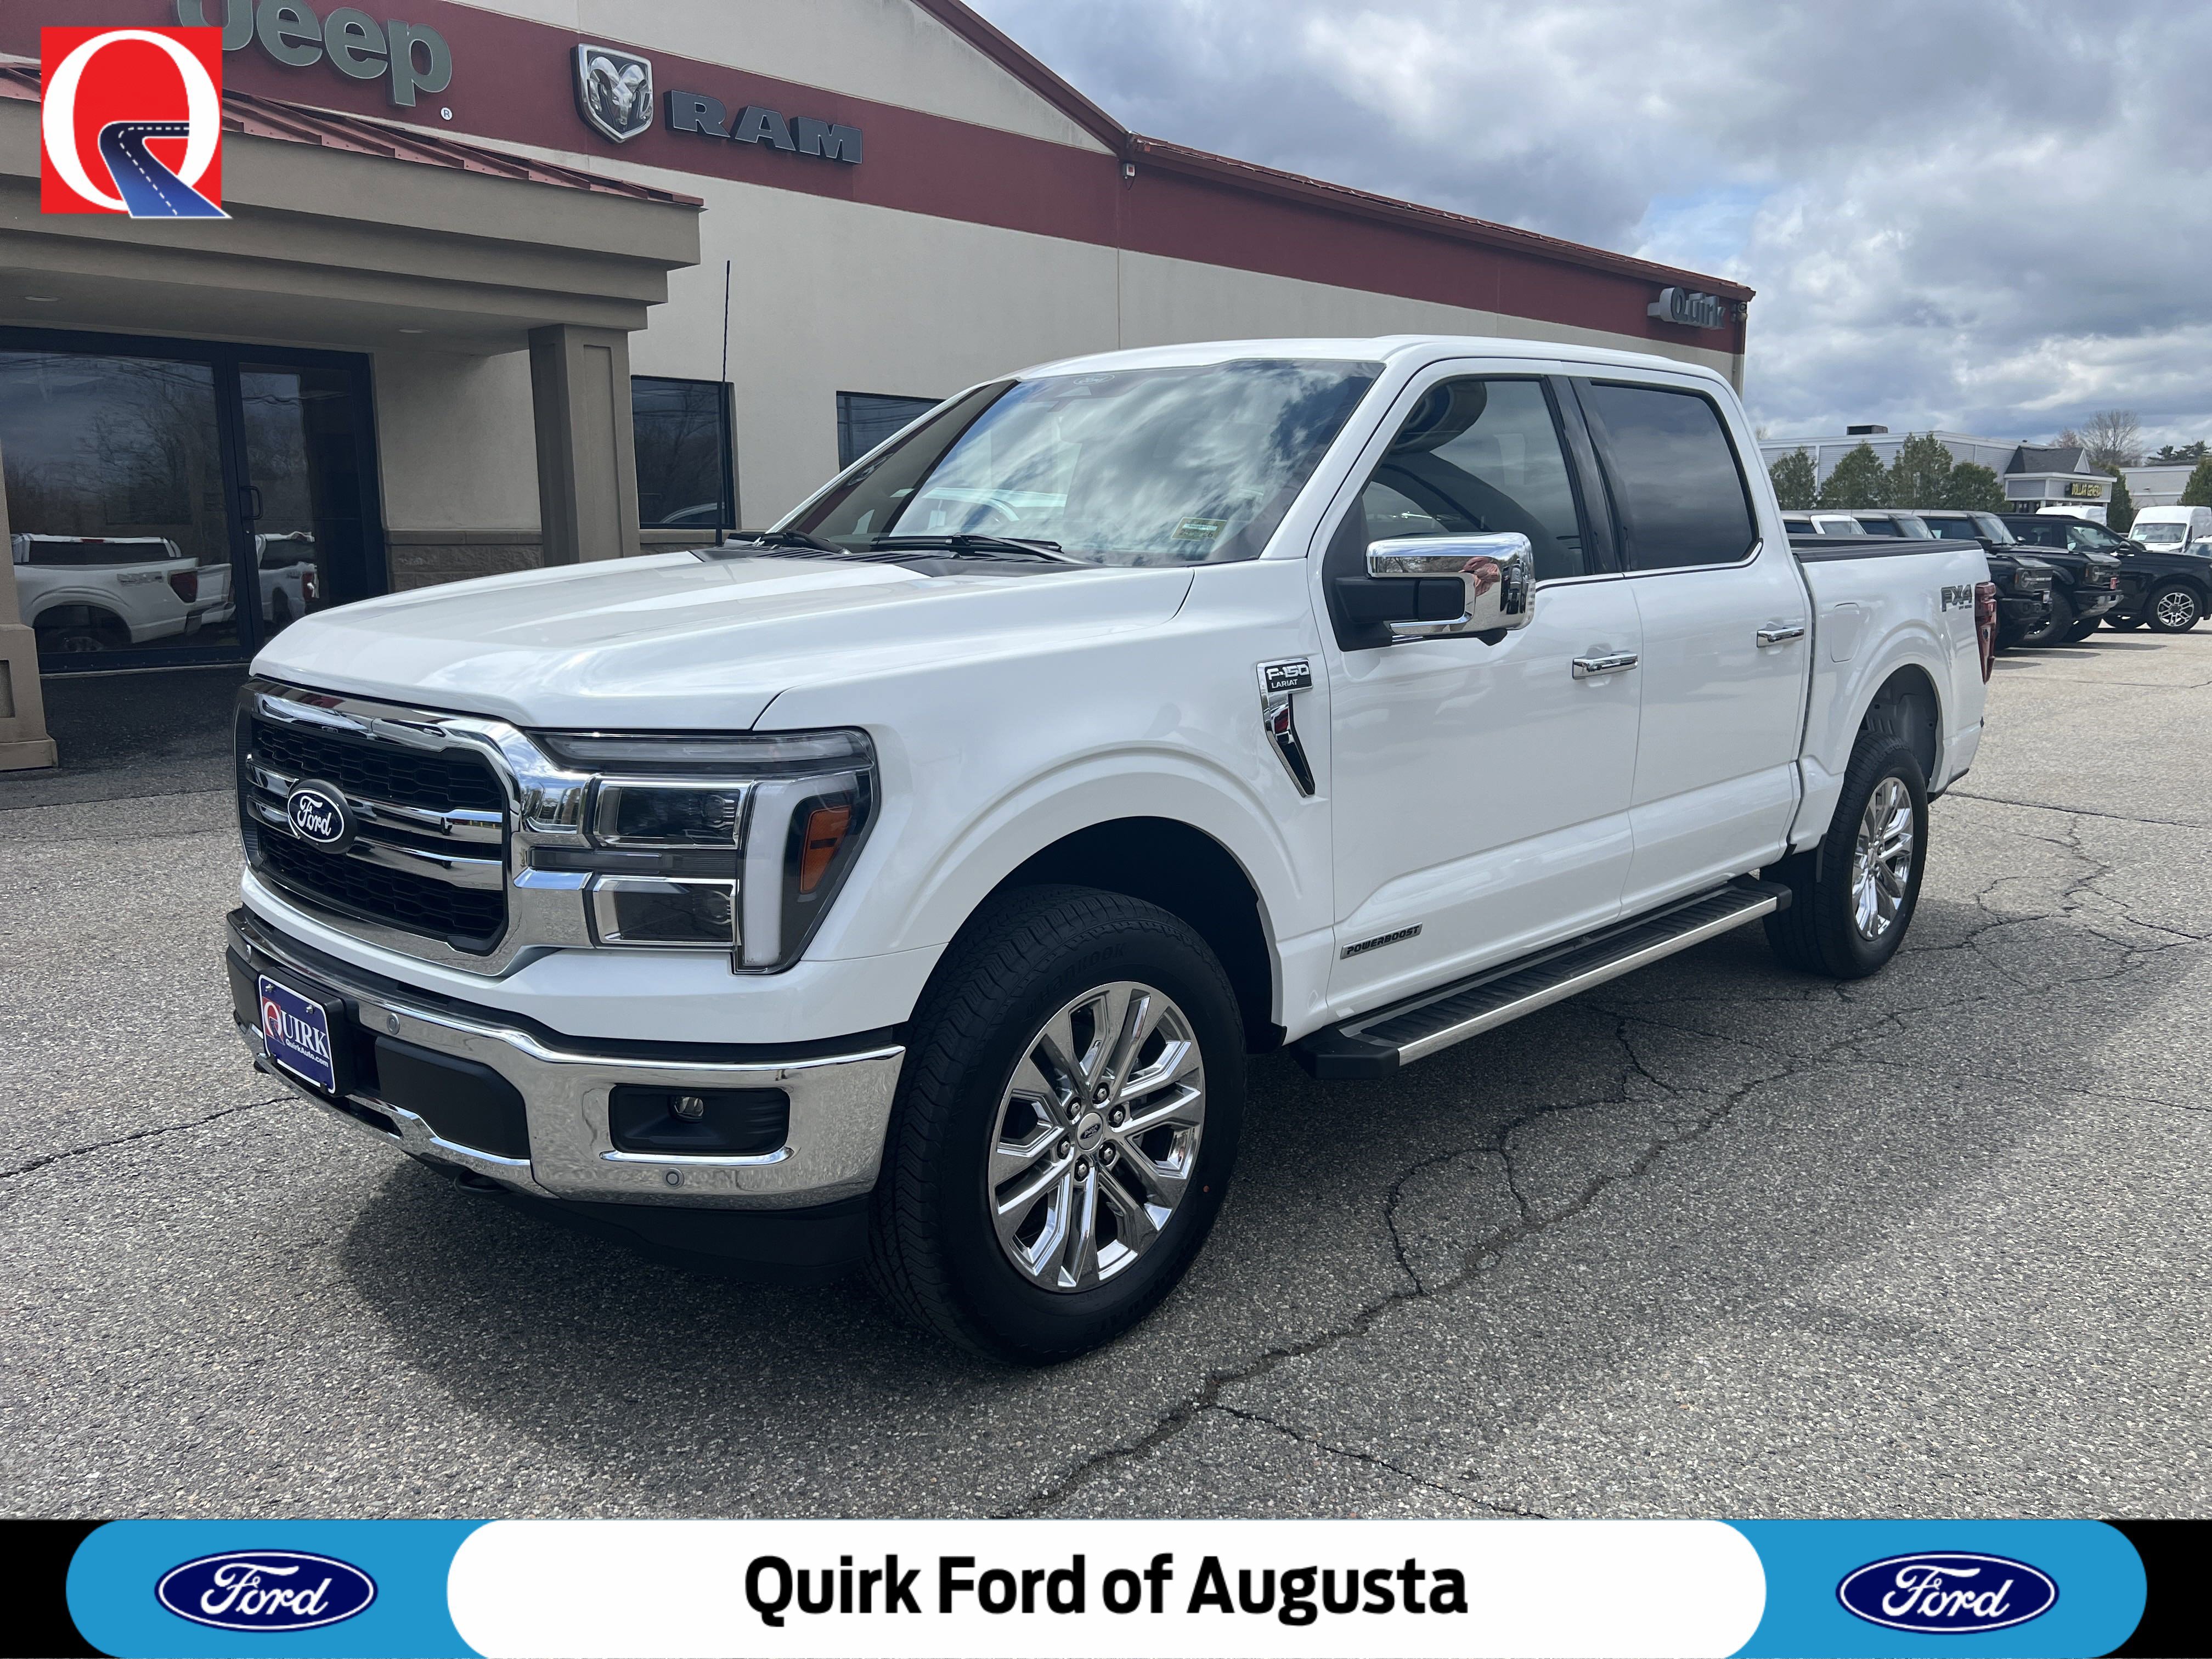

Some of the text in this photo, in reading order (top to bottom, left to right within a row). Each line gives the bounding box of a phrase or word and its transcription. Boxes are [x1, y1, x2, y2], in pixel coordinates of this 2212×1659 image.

[665, 89, 863, 165] RAM
[1660, 286, 1726, 329] Quirk
[1941, 584, 1972, 612] FX4
[1266, 664, 1311, 680] F-150
[1271, 679, 1298, 689] LARIAT
[297, 795, 332, 837] Ford
[1346, 925, 1420, 956] POWERBOOST
[263, 1001, 330, 1060] QUIRK
[285, 1038, 329, 1068] QuirkAuto.com
